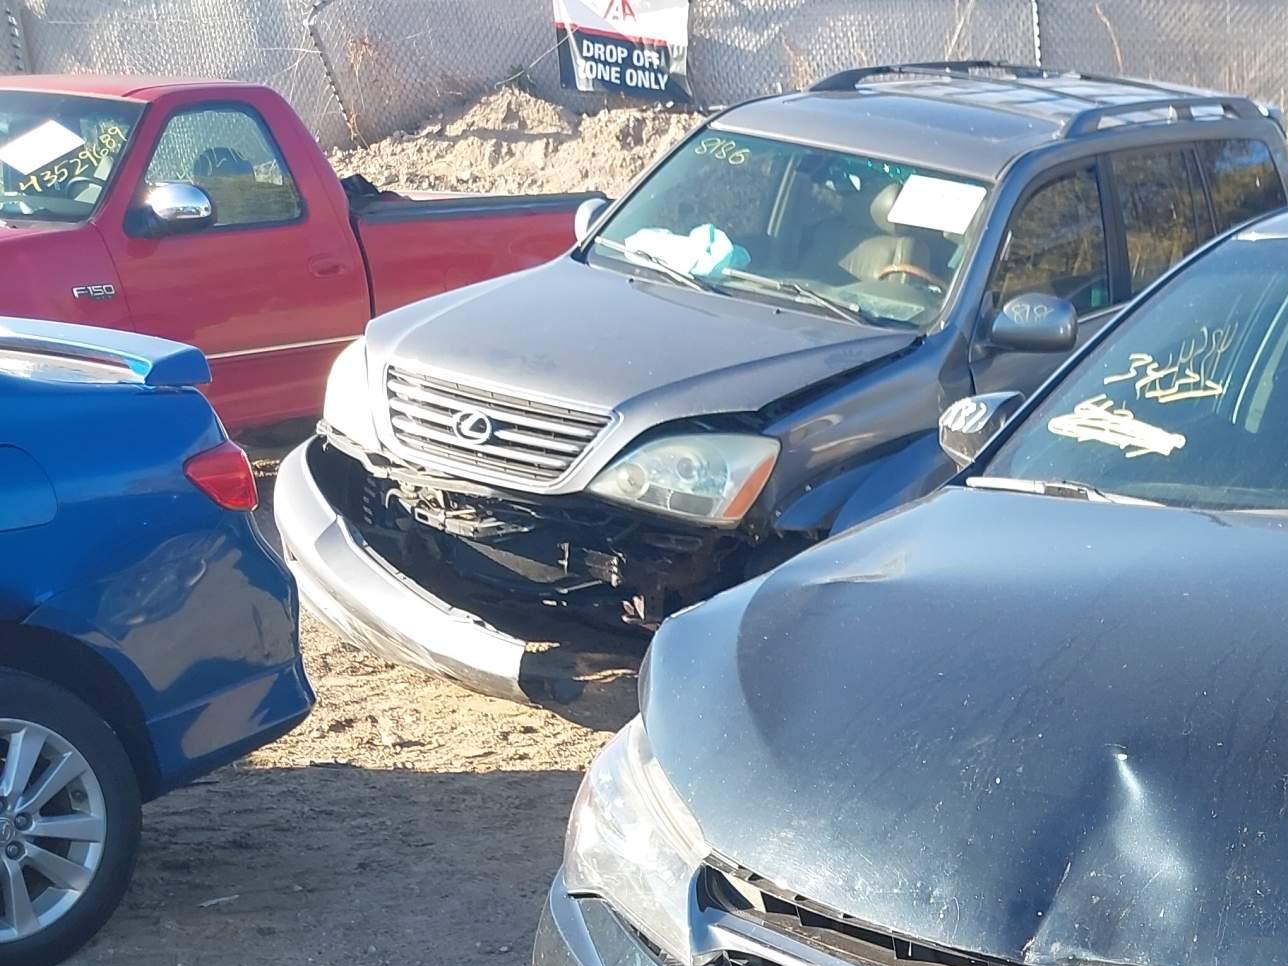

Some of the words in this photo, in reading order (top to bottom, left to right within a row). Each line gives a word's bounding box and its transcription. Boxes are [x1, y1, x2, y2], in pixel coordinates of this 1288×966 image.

[582, 39, 628, 64] DROP
[632, 49, 660, 69] OFF
[625, 68, 669, 91] ONLY
